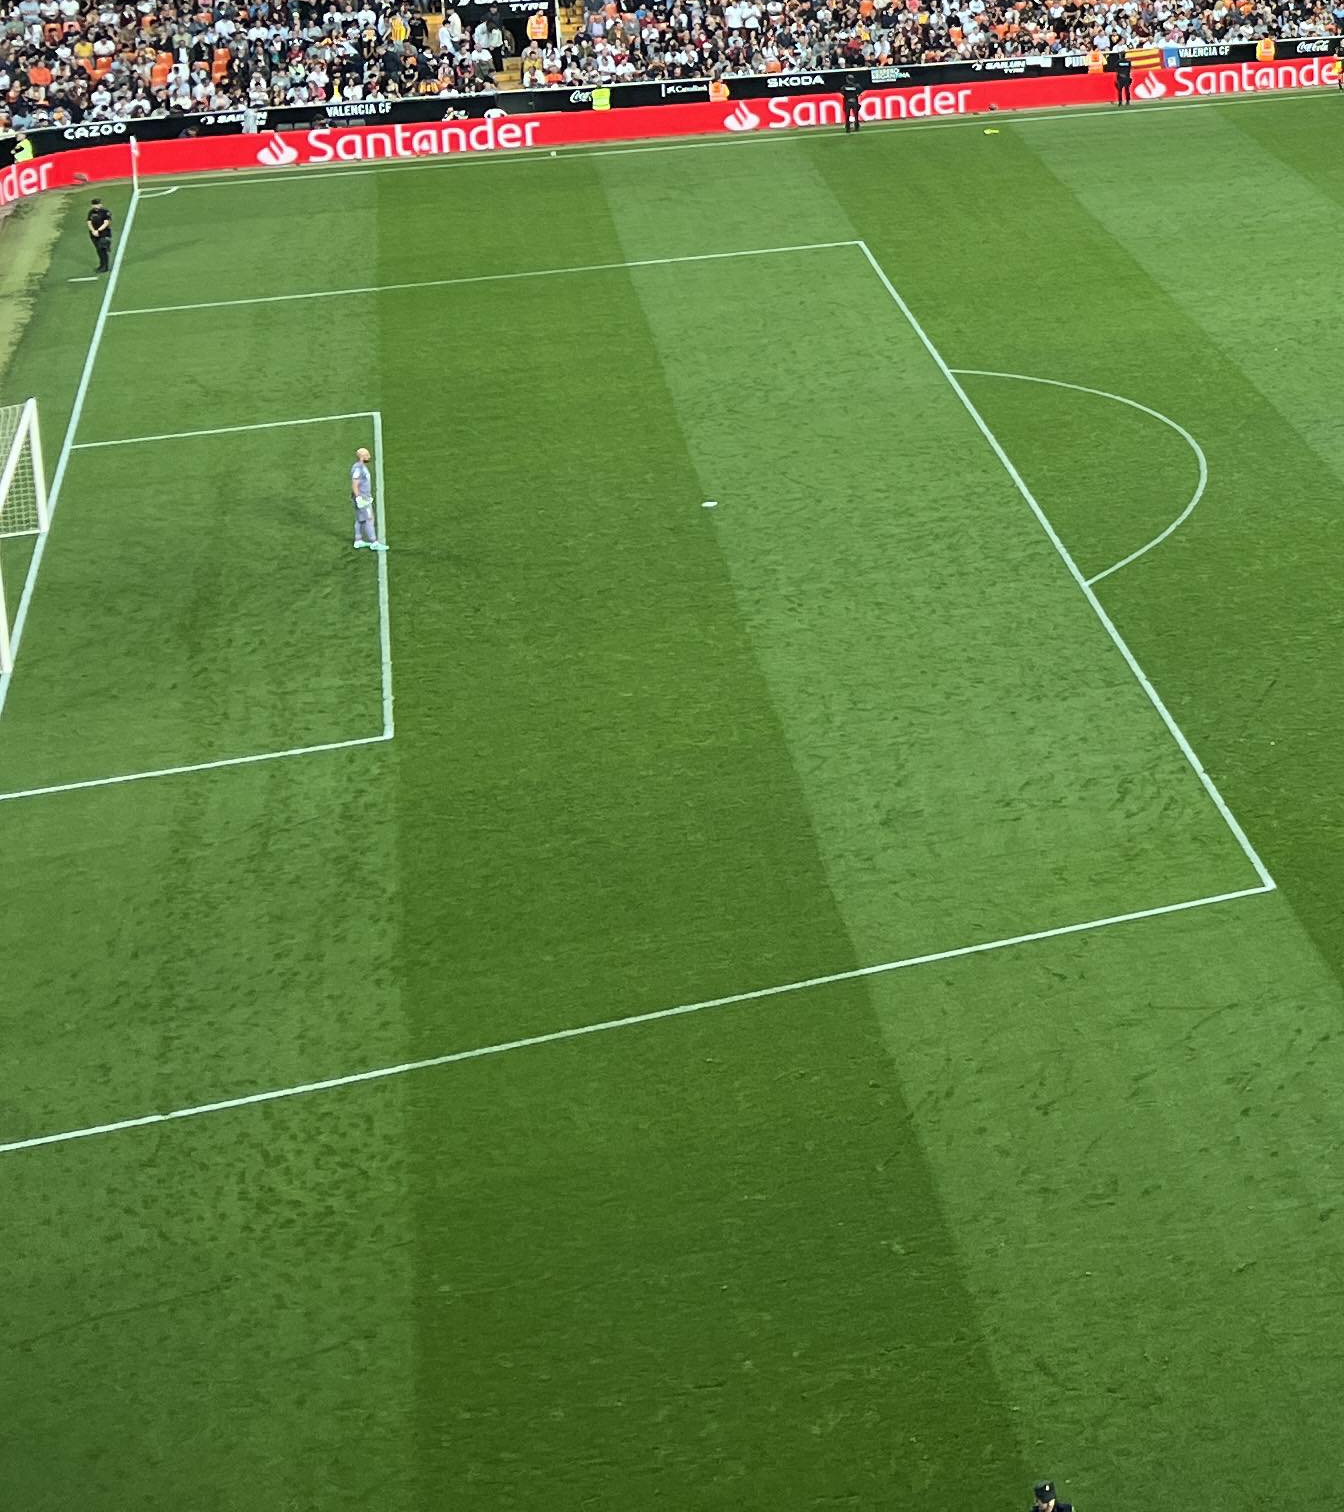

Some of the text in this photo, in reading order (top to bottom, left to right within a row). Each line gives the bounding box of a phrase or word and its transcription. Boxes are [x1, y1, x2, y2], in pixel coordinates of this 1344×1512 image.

[509, 2, 549, 12] TYRE
[1178, 45, 1230, 58] VALENCIA CF
[767, 74, 825, 88] SKODA
[326, 102, 392, 117] VALENCIA CF
[769, 86, 971, 129] Sanander
[64, 122, 127, 140] CAZOO
[307, 116, 540, 164] Santander
